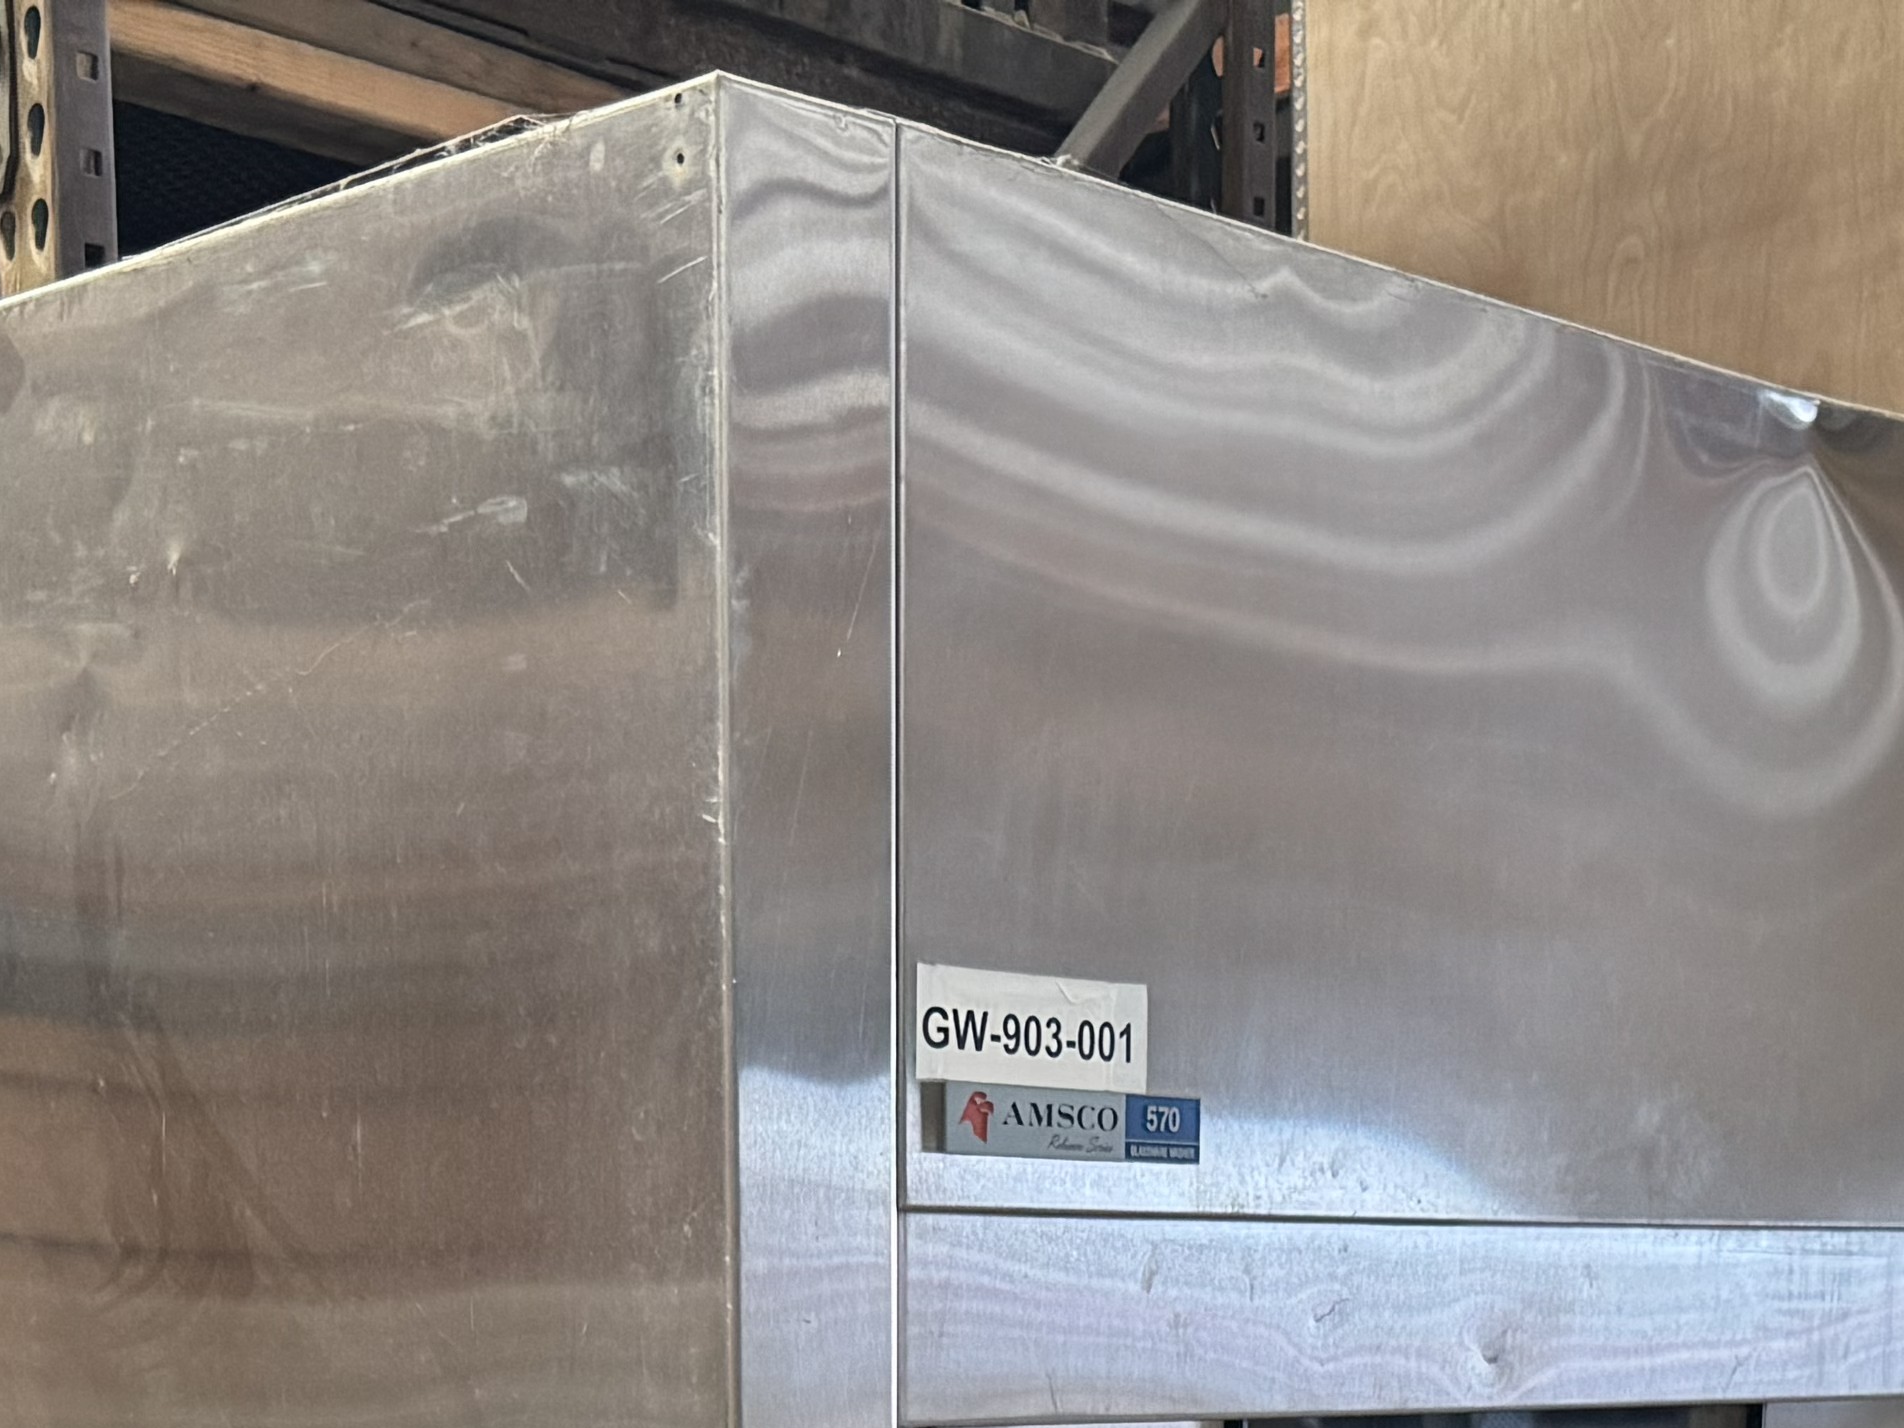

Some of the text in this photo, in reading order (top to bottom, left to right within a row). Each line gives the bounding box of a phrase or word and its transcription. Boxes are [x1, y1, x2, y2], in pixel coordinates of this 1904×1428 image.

[921, 1005, 1132, 1064] GW-903-001
[1001, 1100, 1119, 1132] AMSCO
[1146, 1104, 1181, 1133] 570
